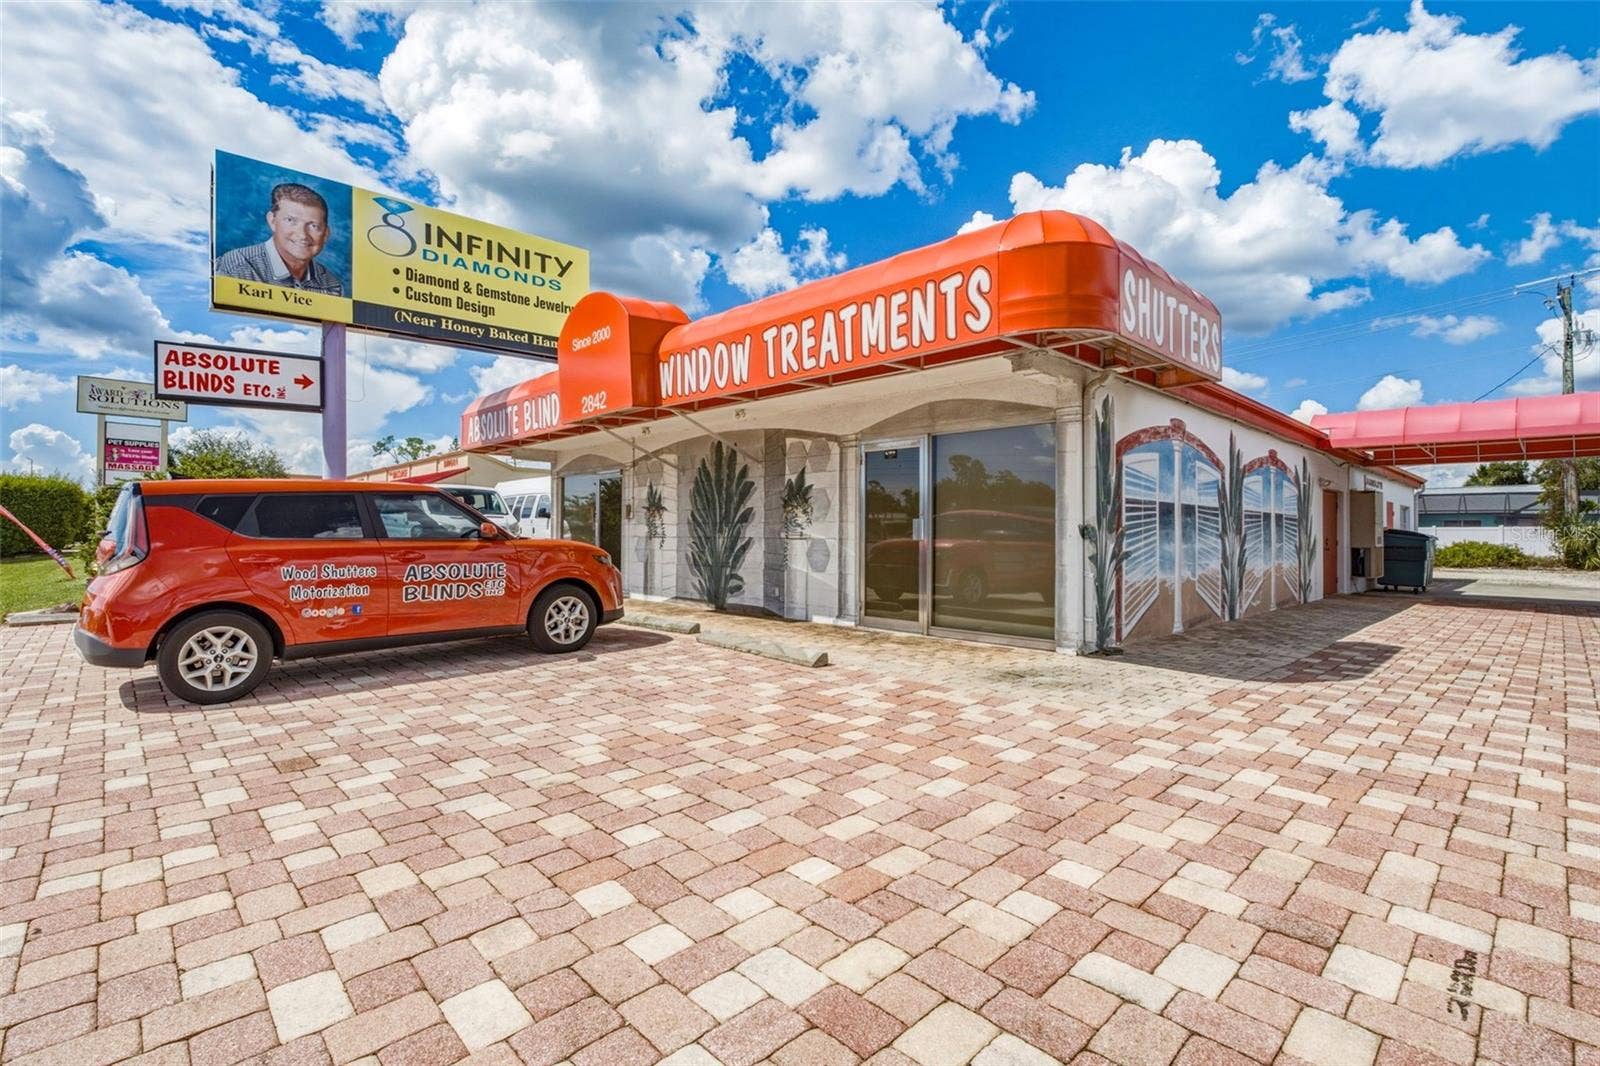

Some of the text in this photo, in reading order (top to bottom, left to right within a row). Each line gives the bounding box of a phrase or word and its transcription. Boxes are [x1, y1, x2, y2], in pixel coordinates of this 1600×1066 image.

[424, 223, 574, 278] INFINITY
[421, 248, 562, 291] DIAMONDS
[238, 282, 313, 306] Karl Vice
[405, 267, 460, 293] Diamond
[463, 280, 472, 294] &
[476, 283, 530, 306] Gemstone
[405, 286, 496, 317] Custom Design
[394, 310, 437, 330] (Near
[440, 317, 485, 340] Honey
[489, 327, 529, 344] Baked
[659, 265, 992, 400] WINDOW TREATMENTS
[1122, 268, 1221, 374] SHUTTERS
[572, 326, 611, 352] Since 2000
[164, 349, 280, 375] ABSOLUTE
[89, 386, 124, 399] AWARD
[163, 370, 235, 395] BLINDS
[243, 383, 276, 398] ETC.
[88, 395, 180, 410] SOLUTIONS
[581, 391, 607, 414] 2842
[467, 392, 560, 445] ABSOLUTE BLIND
[124, 440, 160, 448] SUPPLIES
[107, 463, 156, 471] MASSAGE
[281, 563, 377, 582] Wood Shutters
[403, 562, 506, 582] ABSOLUTE
[289, 584, 369, 601] Motorization
[403, 583, 484, 604] BLINDS
[301, 606, 346, 618] Google
